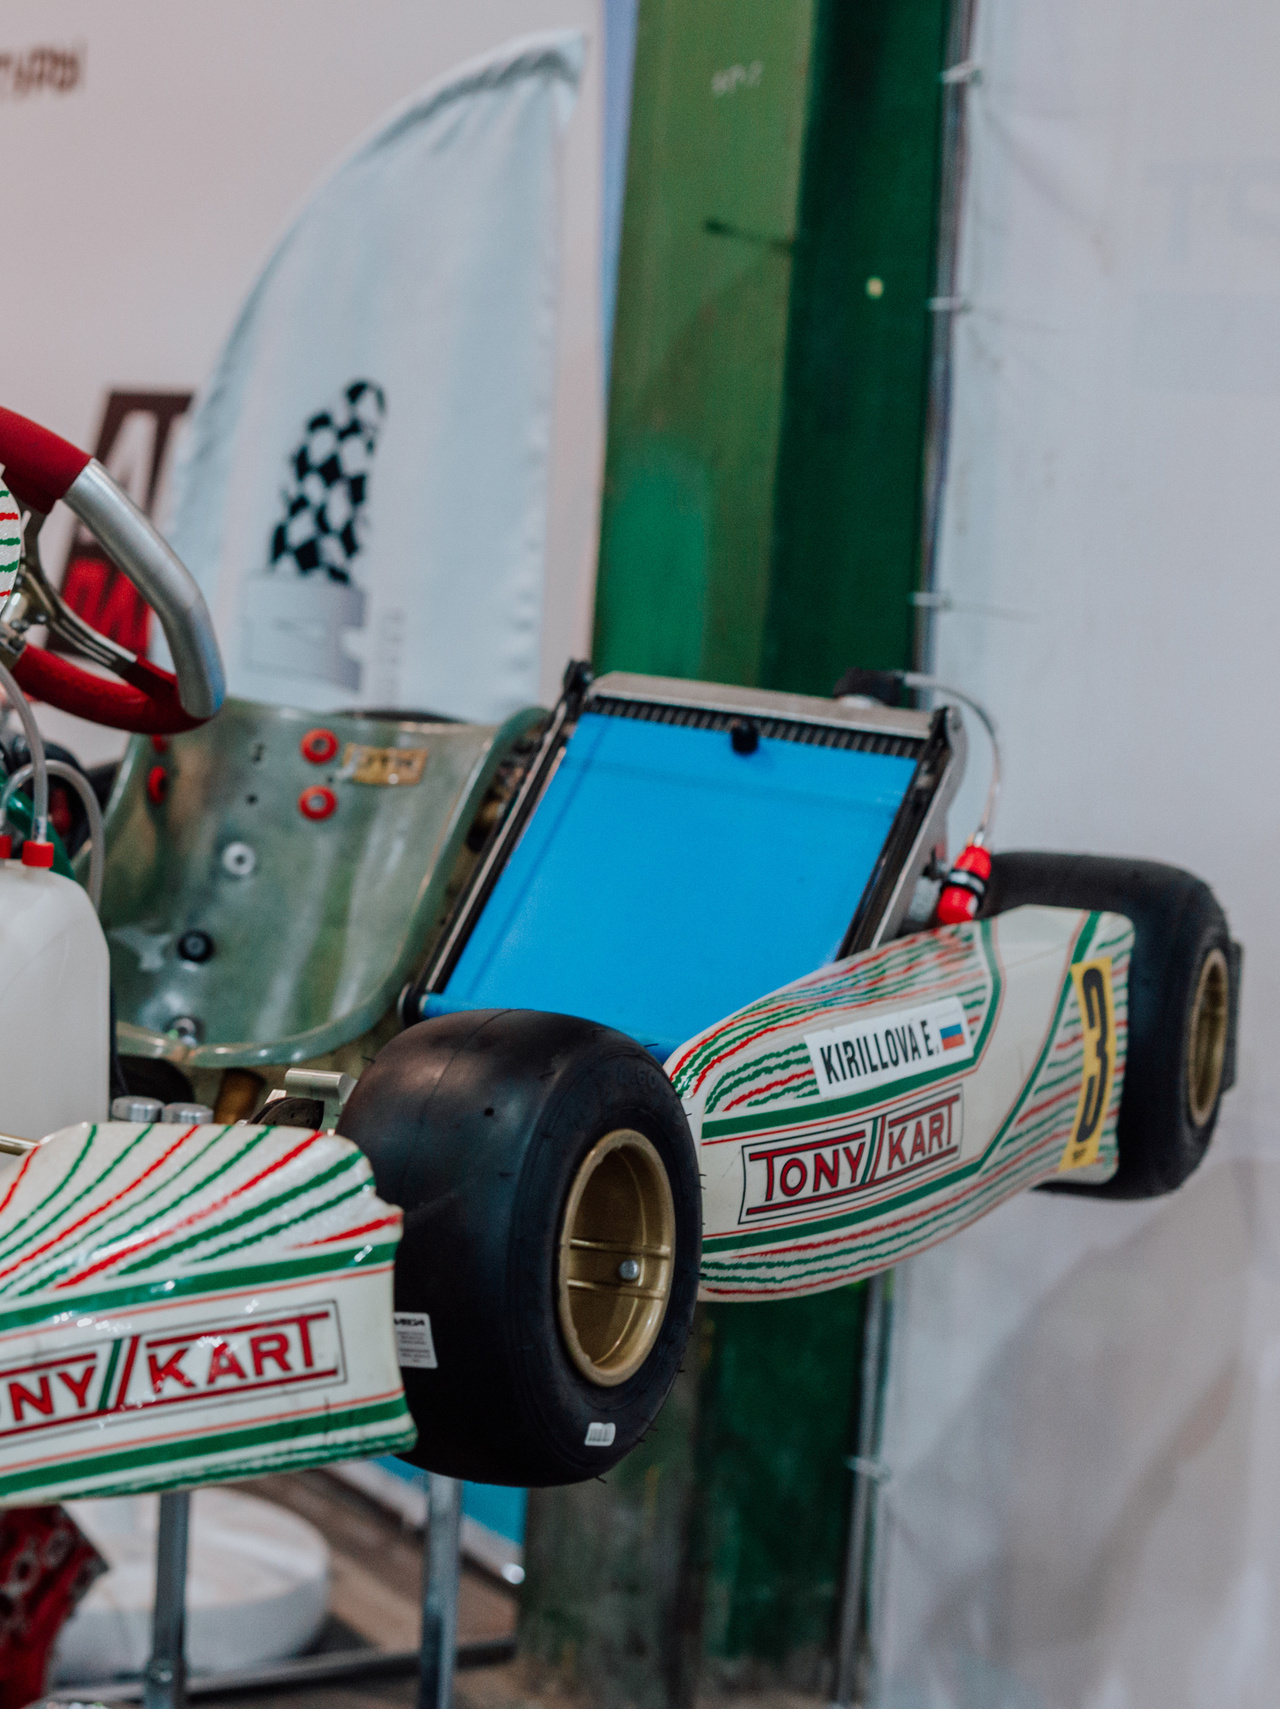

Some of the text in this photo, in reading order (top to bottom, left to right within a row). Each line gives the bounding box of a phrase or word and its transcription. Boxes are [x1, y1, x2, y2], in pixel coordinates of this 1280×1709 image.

[819, 1024, 922, 1085] KIRILLOVA
[1074, 966, 1113, 1144] 3
[748, 1092, 961, 1202] TONY KART
[144, 1310, 331, 1395] KART
